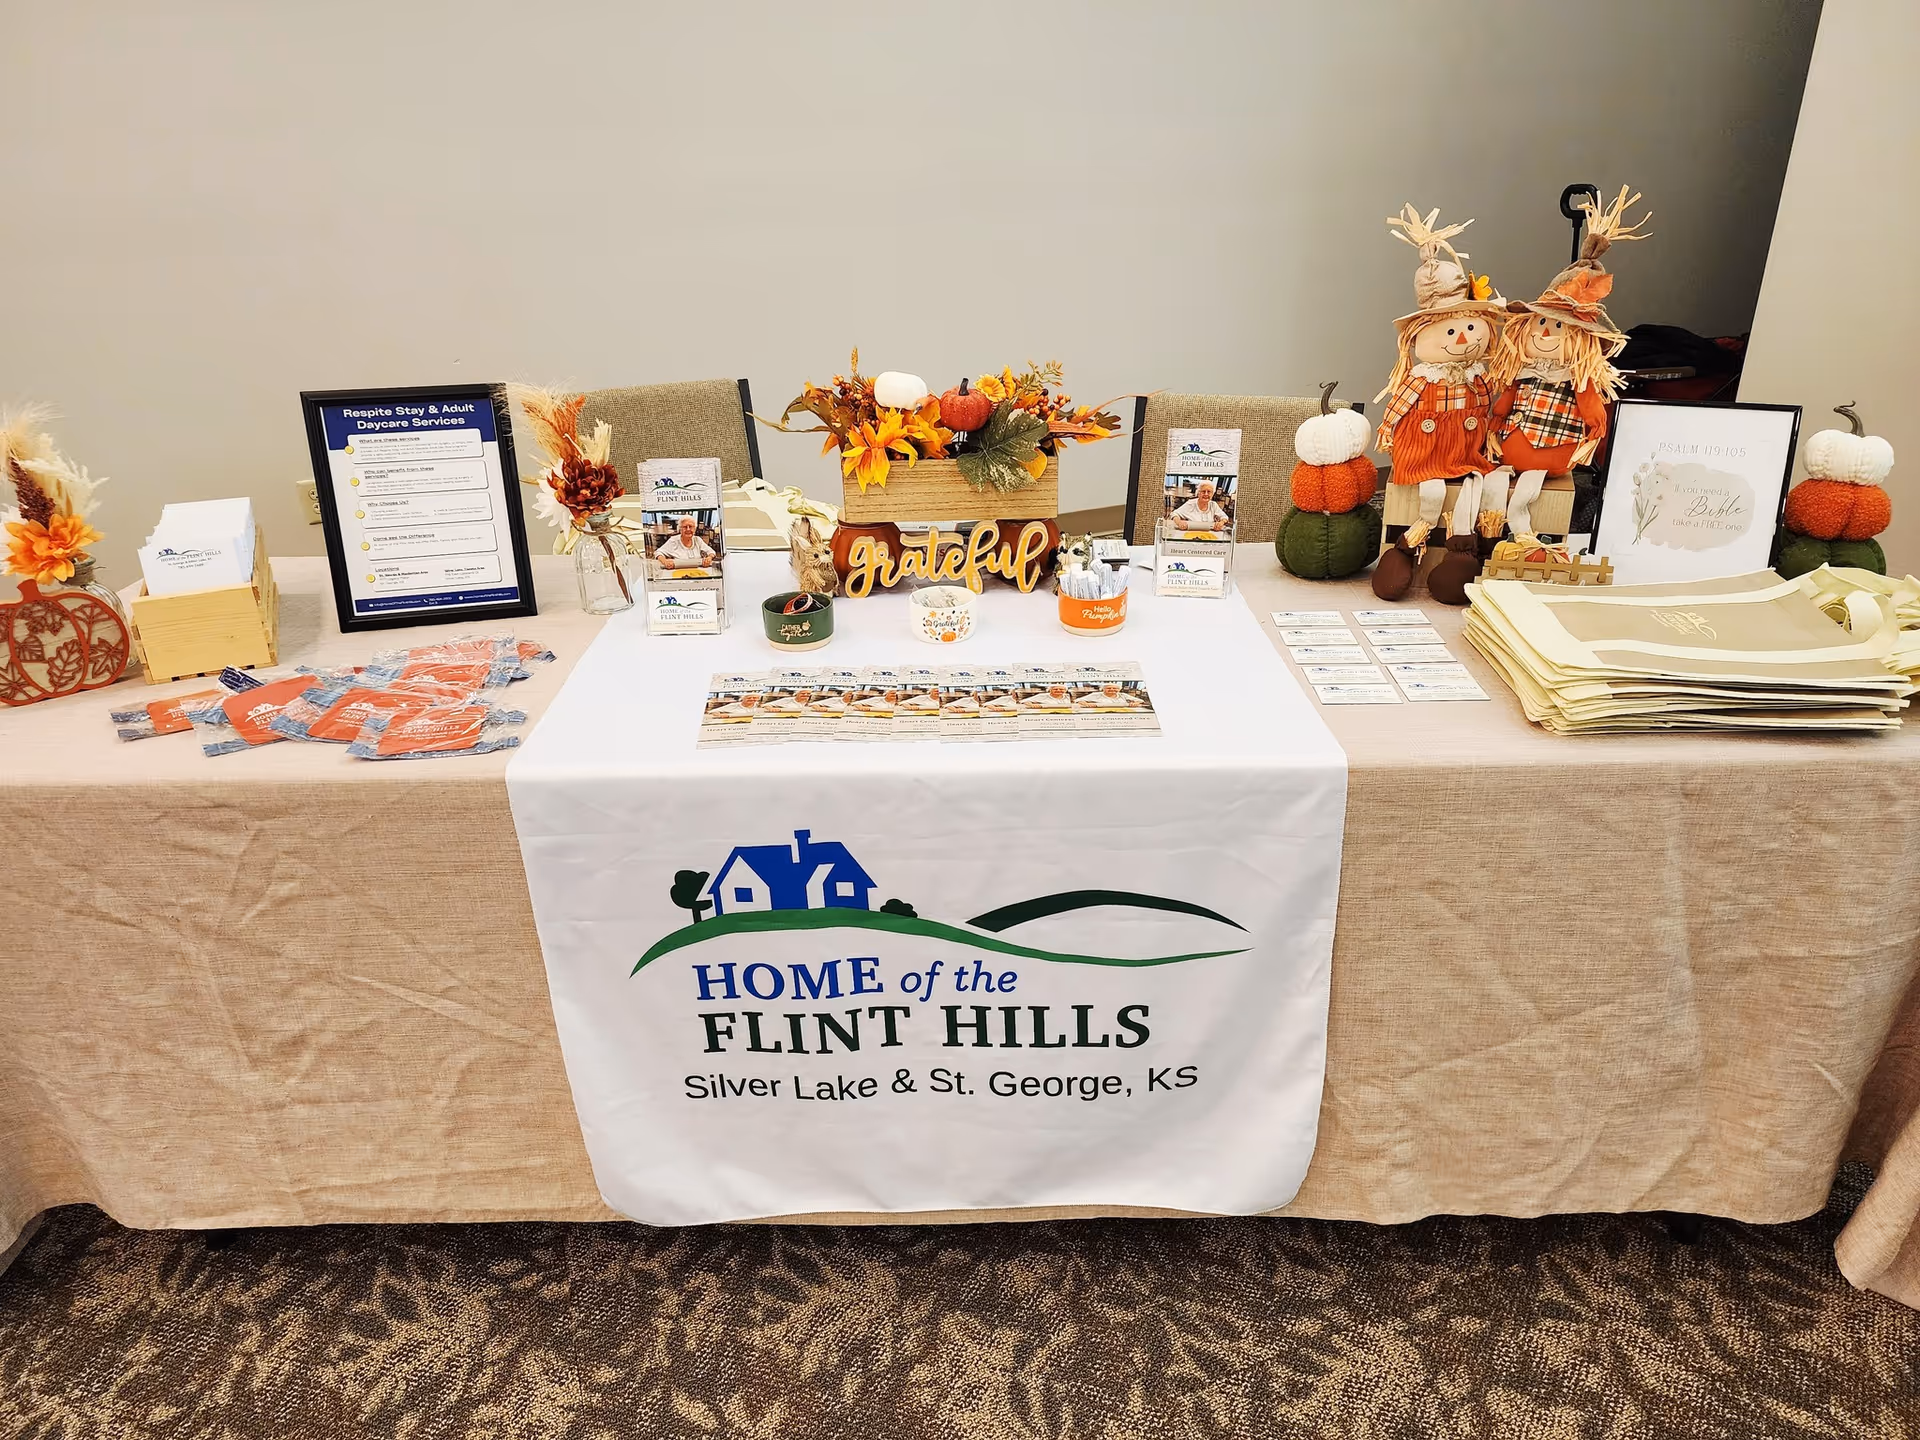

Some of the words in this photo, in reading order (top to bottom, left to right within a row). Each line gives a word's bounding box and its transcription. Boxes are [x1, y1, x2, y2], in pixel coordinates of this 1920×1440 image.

[343, 407, 393, 420] Respite
[395, 405, 425, 417] Stay
[428, 405, 439, 414] &
[442, 403, 475, 414] Adult
[356, 418, 409, 430] Daycare
[411, 416, 466, 428] Services
[1658, 442, 1699, 455] PSALM
[1704, 444, 1747, 458] 119:105
[1682, 486, 1698, 495] you
[1700, 486, 1722, 496] need
[1684, 495, 1748, 518] Bible
[1672, 519, 1692, 528] take
[1700, 519, 1723, 530] FREE
[845, 519, 1049, 599] grateful
[1082, 609, 1119, 624] Pumpkin
[1094, 605, 1112, 613] Hello
[253, 711, 279, 722] HOME
[692, 957, 884, 1000] HOME
[900, 961, 940, 1002] of
[954, 960, 1018, 993] the
[698, 1005, 911, 1054] FLINT
[942, 1004, 1151, 1048] HILLS
[684, 1072, 781, 1100] Silver
[794, 1073, 878, 1101] Lake
[891, 1067, 918, 1094] &
[929, 1067, 975, 1096] St.
[988, 1070, 1134, 1102] George,
[1148, 1065, 1199, 1091] KS
